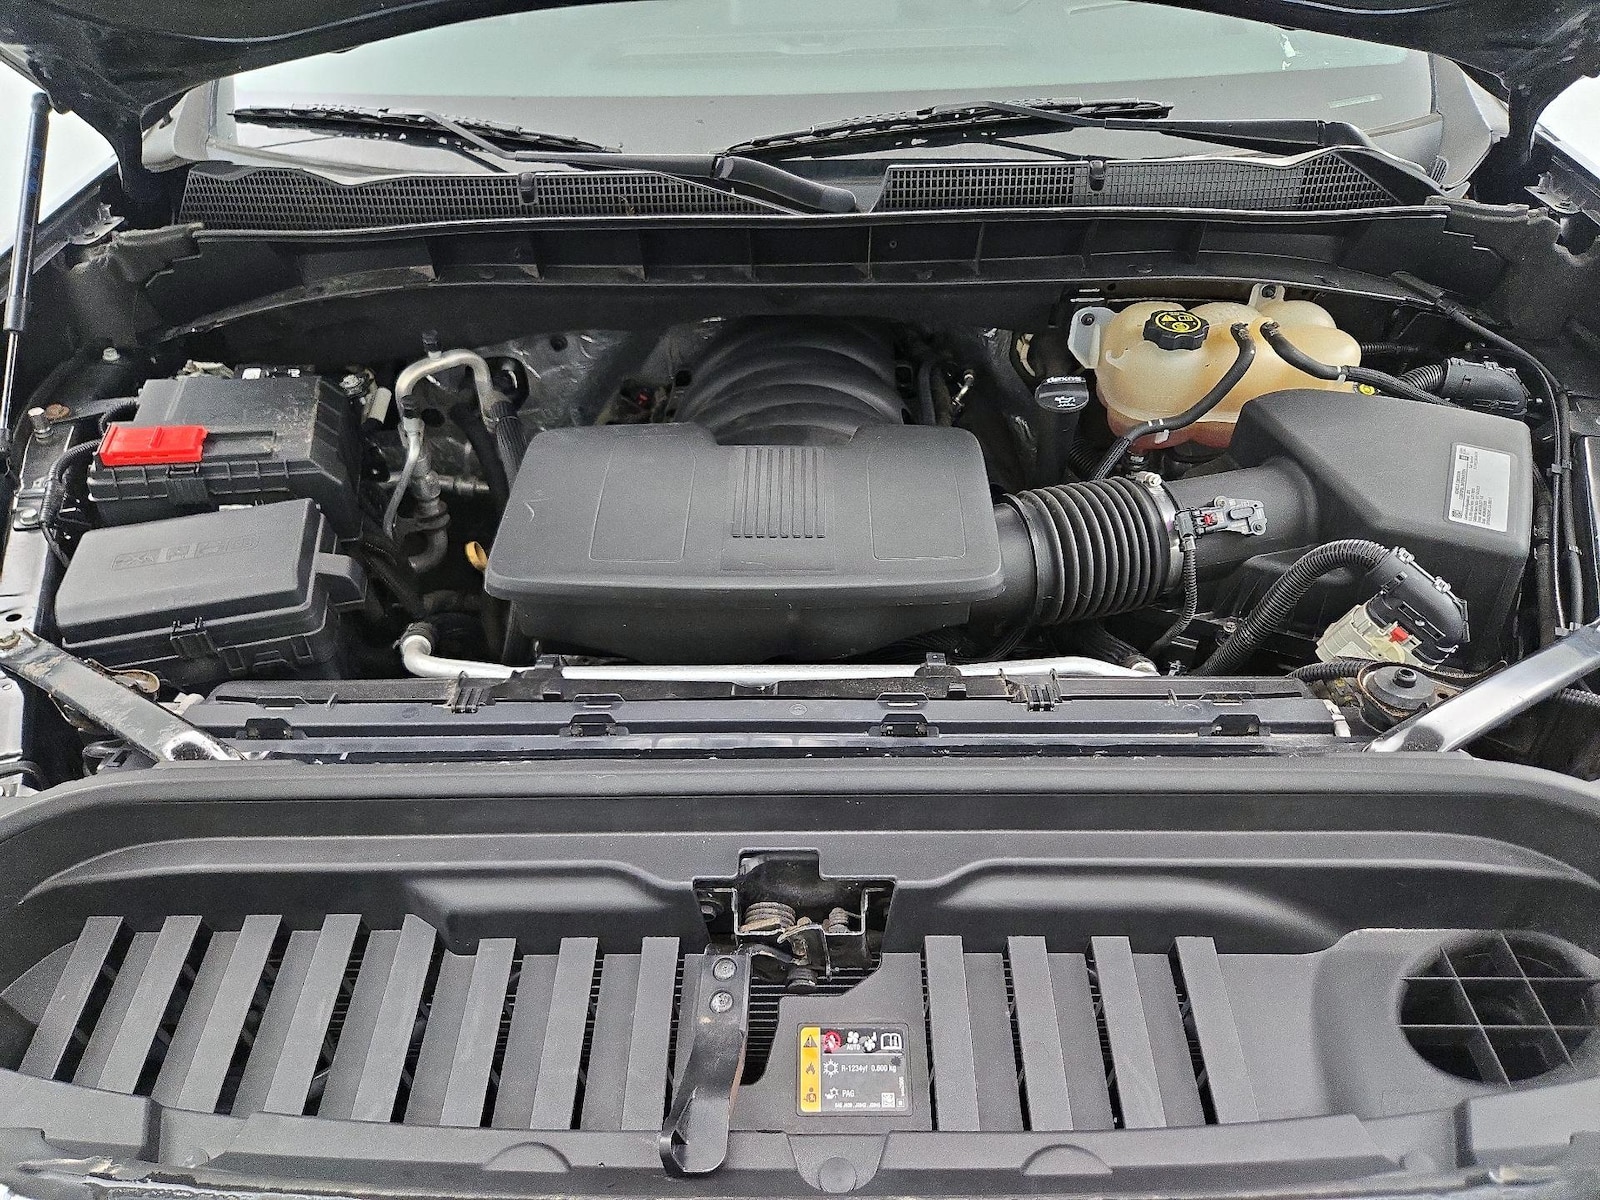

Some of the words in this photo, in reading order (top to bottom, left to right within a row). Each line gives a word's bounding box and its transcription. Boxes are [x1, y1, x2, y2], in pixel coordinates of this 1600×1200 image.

[846, 1043, 861, 1051] AUTO
[841, 1064, 869, 1074] R-1234yf
[888, 1063, 897, 1073] kg
[842, 1090, 855, 1098] PAG
